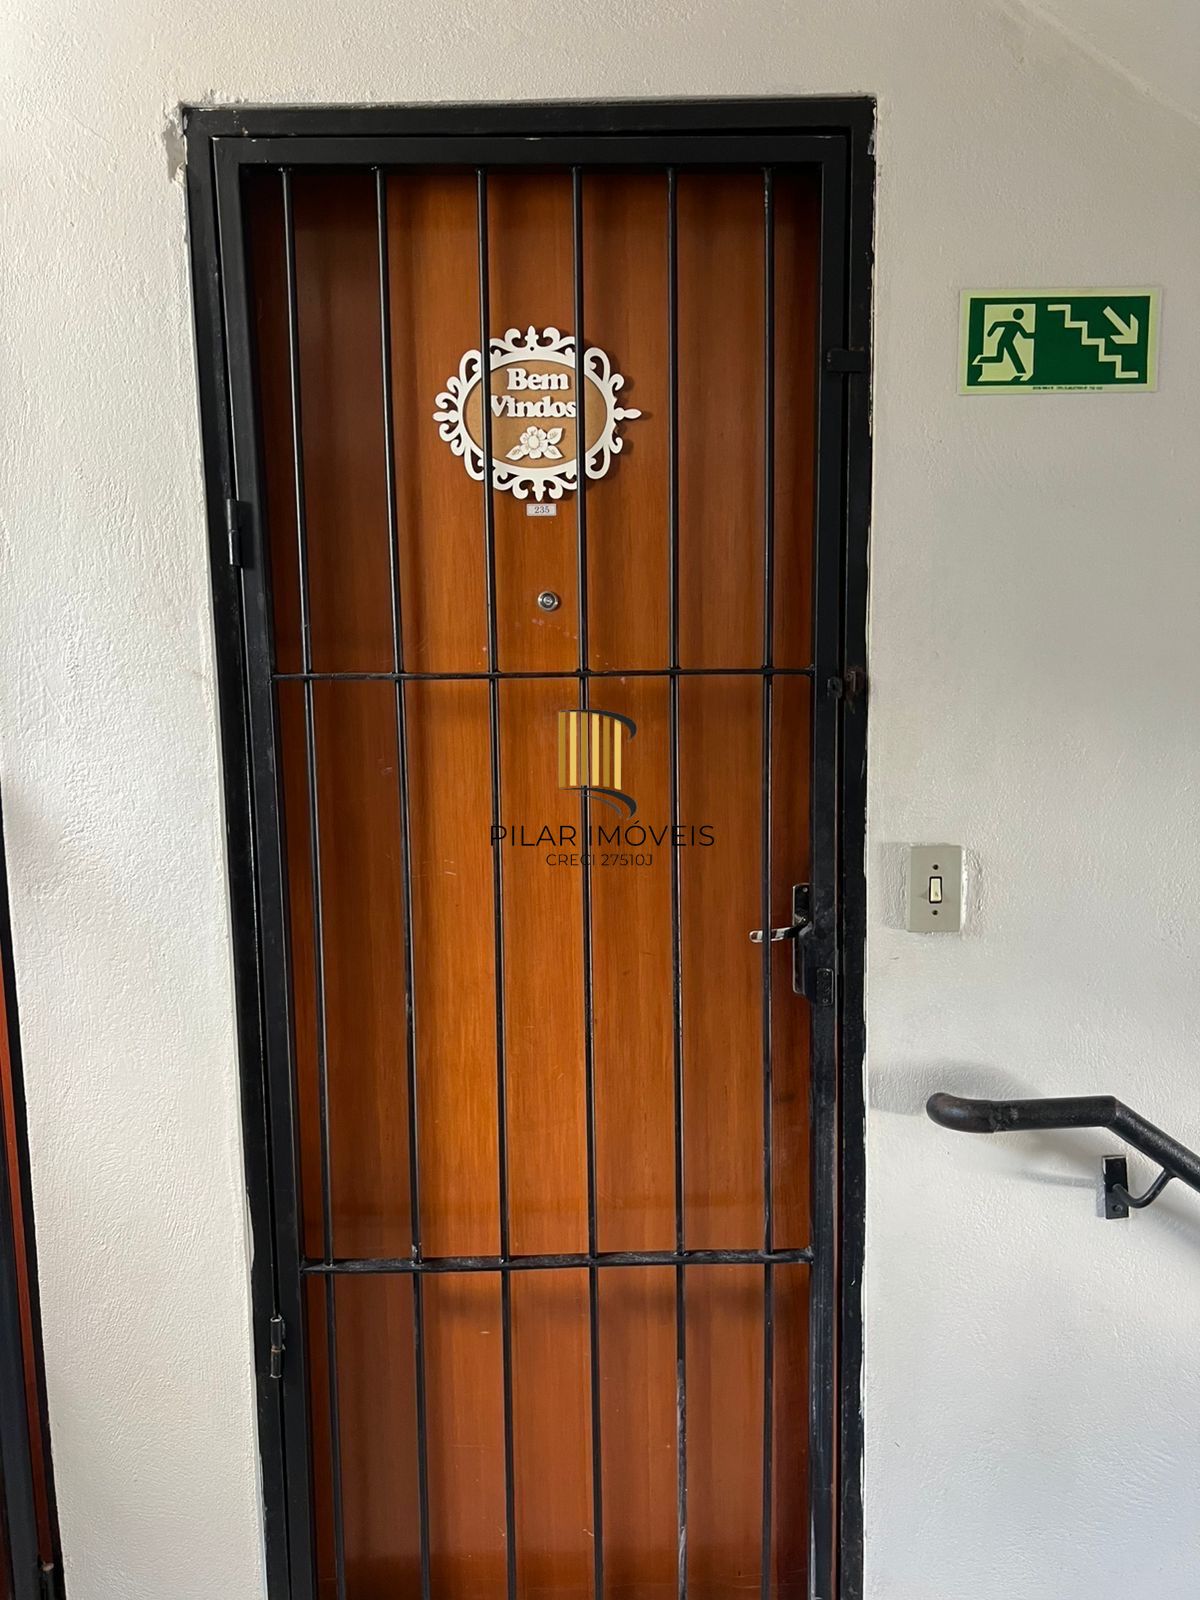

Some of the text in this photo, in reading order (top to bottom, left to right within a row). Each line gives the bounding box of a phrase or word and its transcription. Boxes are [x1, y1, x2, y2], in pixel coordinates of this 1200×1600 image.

[507, 368, 569, 390] Bem
[491, 395, 577, 418] Vindos
[534, 505, 550, 514] 235
